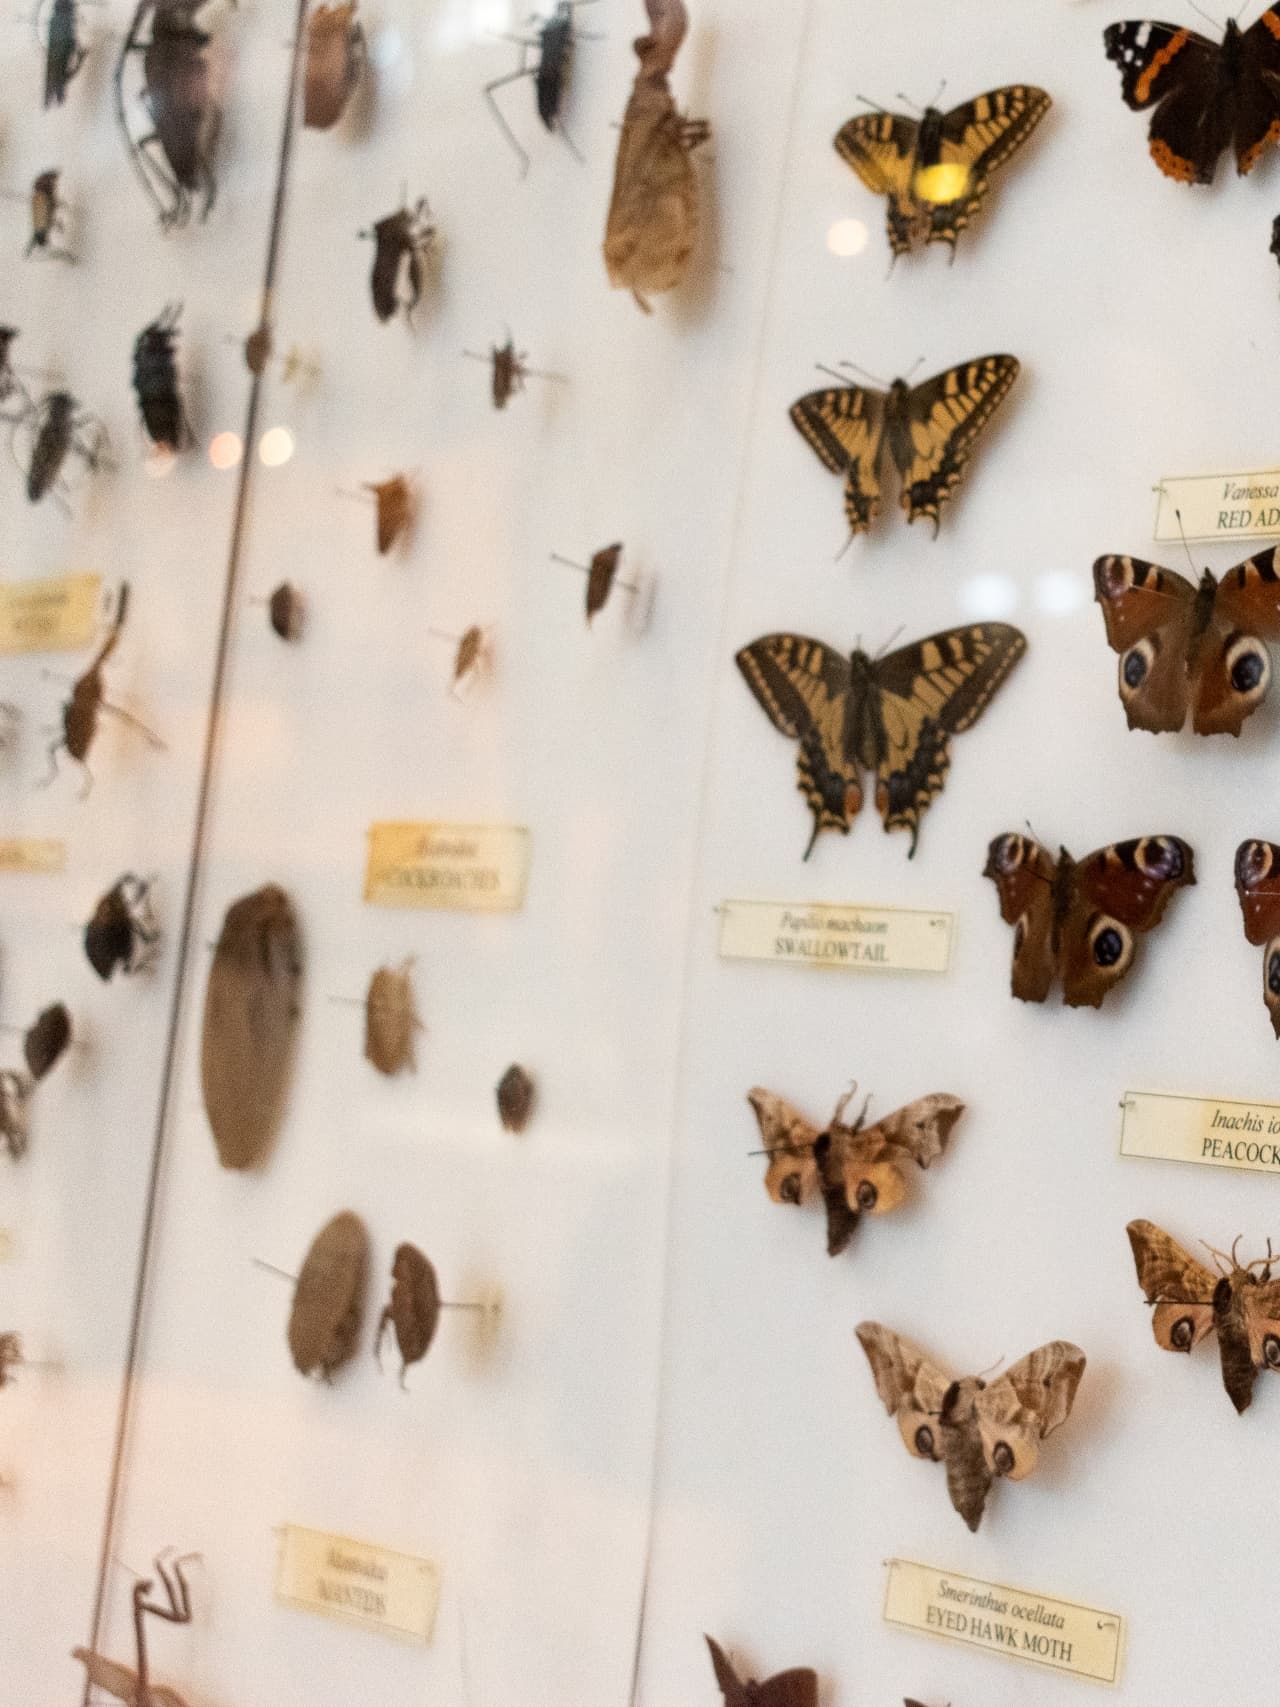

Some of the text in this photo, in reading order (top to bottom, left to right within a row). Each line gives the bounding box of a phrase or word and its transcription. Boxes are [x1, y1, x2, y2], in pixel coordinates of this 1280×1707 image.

[1223, 481, 1279, 501] Vanessa
[1216, 509, 1252, 530] RED
[774, 936, 890, 962] SWALLOWTAIL
[1210, 1108, 1265, 1133] Inachis
[937, 1578, 1066, 1630] Smerinthus ocellata
[925, 1604, 1073, 1663] EYED HAWK MOTH
